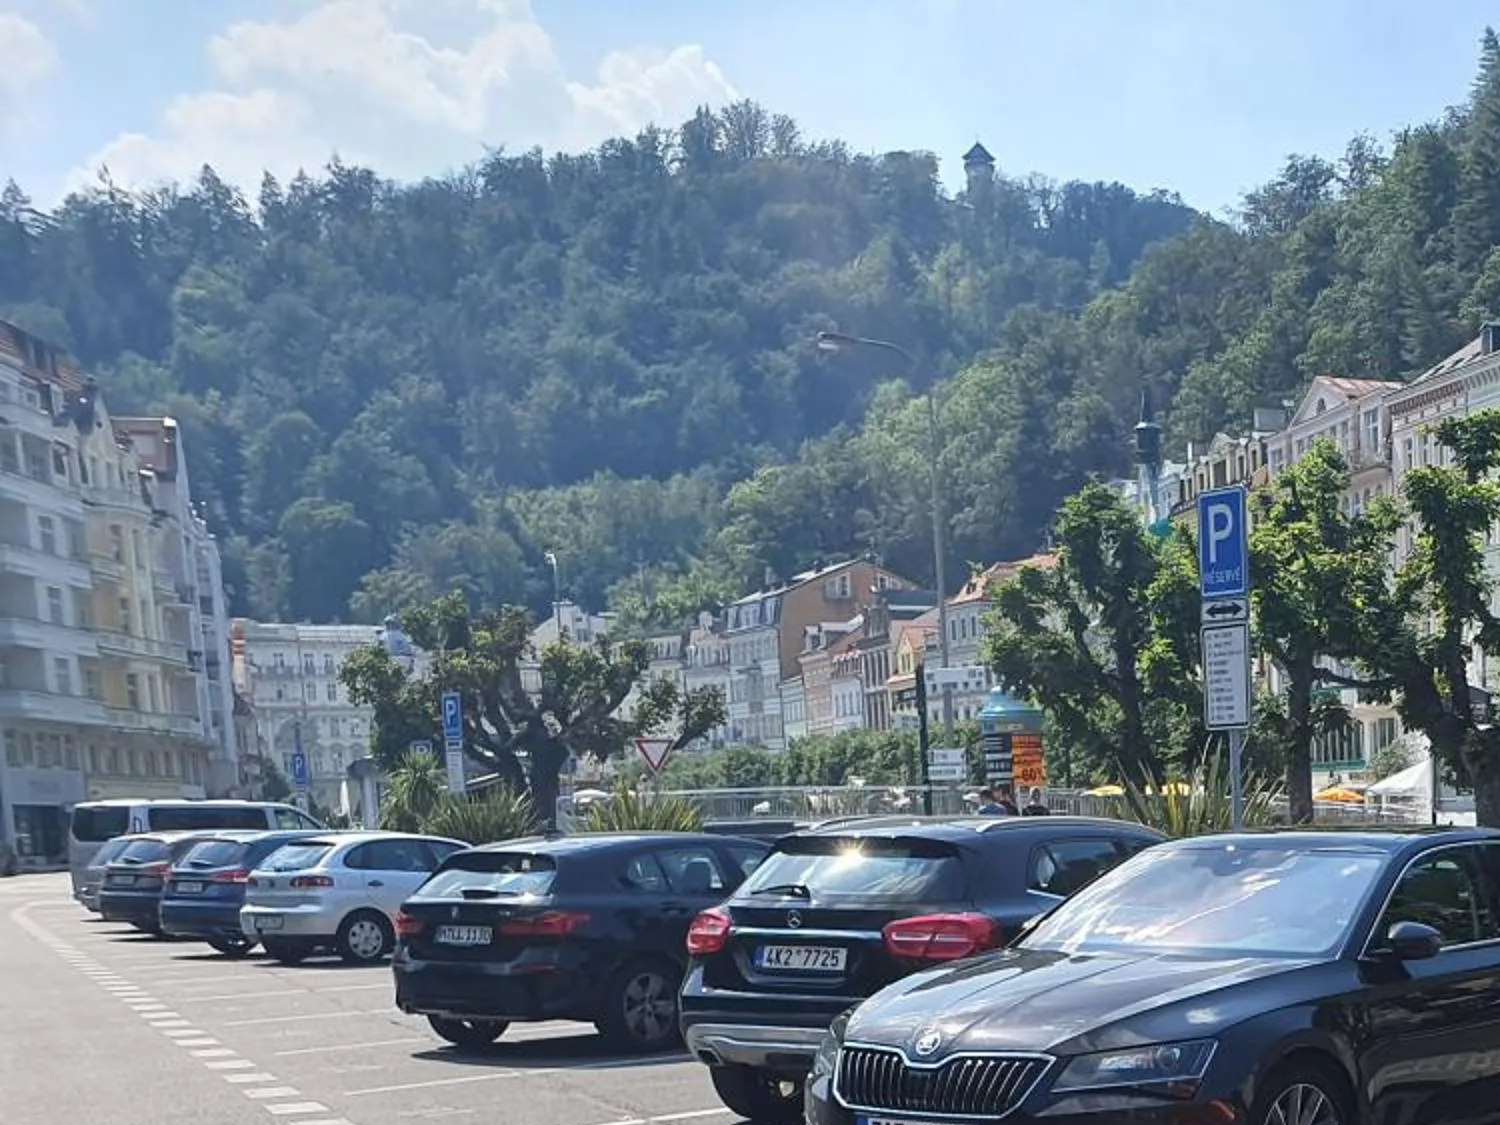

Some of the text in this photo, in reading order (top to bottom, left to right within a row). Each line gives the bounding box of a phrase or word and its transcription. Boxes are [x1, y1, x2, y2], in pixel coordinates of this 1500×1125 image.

[1207, 503, 1233, 563] P
[446, 701, 457, 725] P
[766, 948, 840, 967] 4K2 7725
